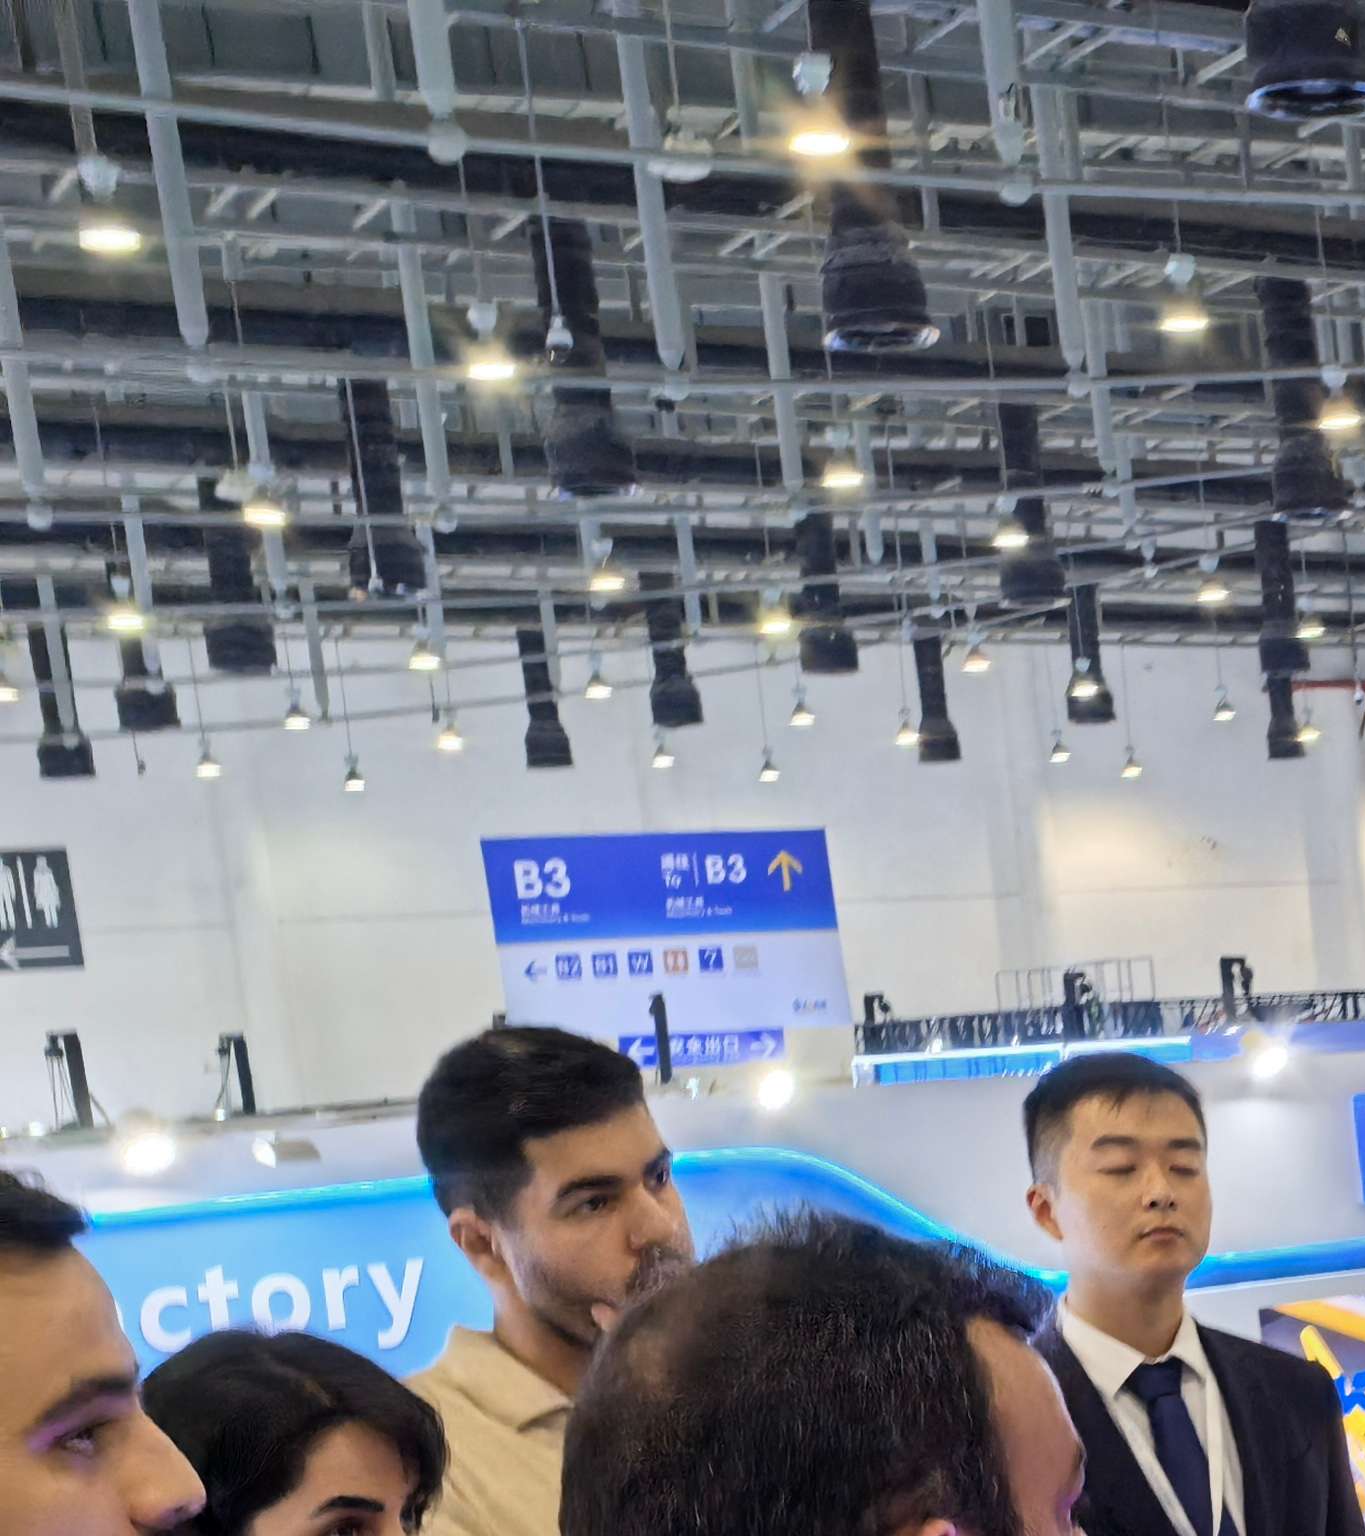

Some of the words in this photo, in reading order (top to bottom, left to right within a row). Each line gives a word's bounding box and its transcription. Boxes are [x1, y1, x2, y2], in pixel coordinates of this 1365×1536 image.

[513, 857, 572, 900] B3
[705, 853, 748, 885] B3
[114, 1256, 425, 1353] ctory
